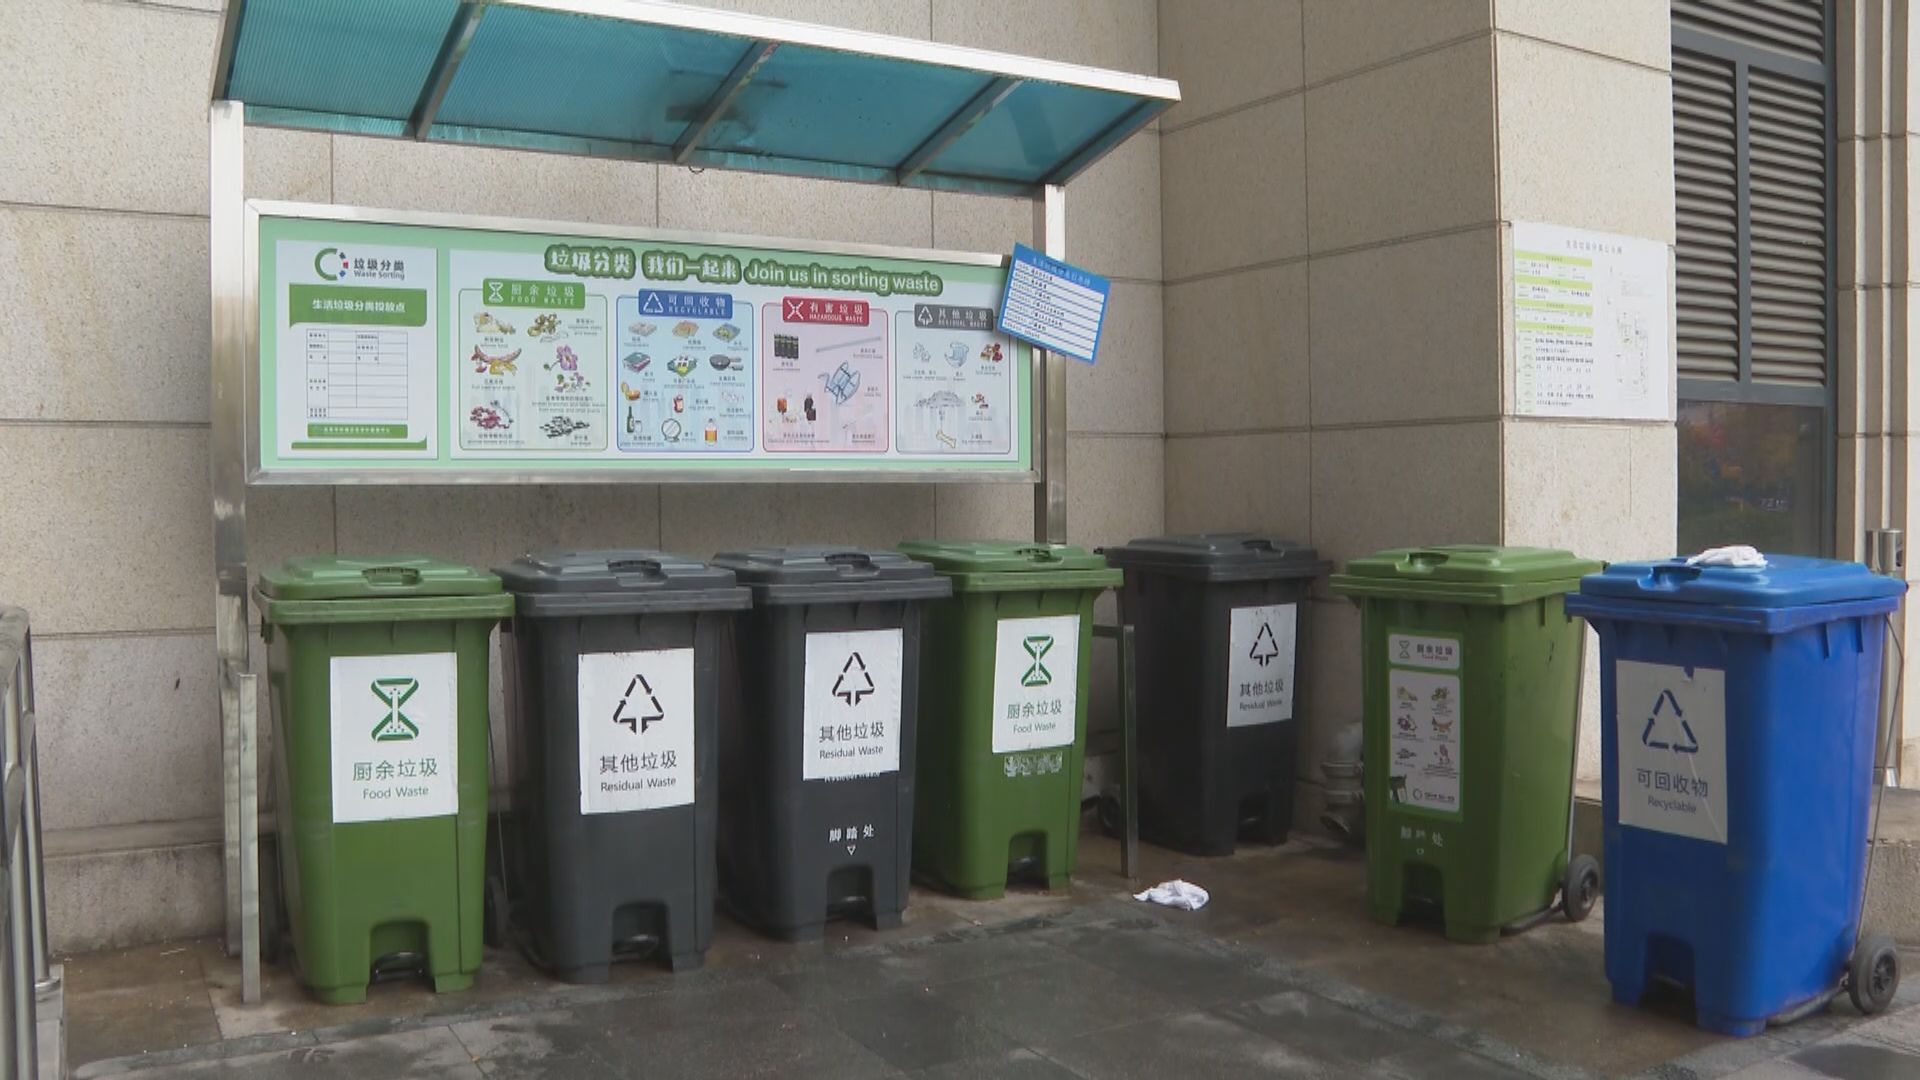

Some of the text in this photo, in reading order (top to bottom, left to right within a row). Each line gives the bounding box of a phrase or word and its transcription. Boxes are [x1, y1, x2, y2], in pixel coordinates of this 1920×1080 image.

[354, 257, 405, 272] 垃圾分类
[550, 250, 939, 292] 垃圾分类 我们一起来 Join us in sorting waste
[354, 270, 405, 280] Waste Sorting
[511, 284, 575, 298] 厨余垃圾
[511, 296, 575, 305] FOOD WASTE
[668, 294, 726, 308] 可回收物
[809, 302, 863, 315] 有害垃圾
[938, 308, 987, 320] 其他垃圾
[809, 314, 863, 323] HAZARDOUS WASTE
[1416, 643, 1453, 656] 厨余垃圾
[1239, 678, 1284, 697] 其他垃圾
[1007, 699, 1062, 719] 厨余垃圾
[1240, 700, 1266, 711] Residual
[819, 721, 885, 743] 其他垃圾
[1013, 722, 1056, 734] Food Waste
[819, 745, 883, 760] Residual Waste
[353, 758, 438, 781] 厨余垃圾
[599, 750, 677, 774] 其他垃圾
[600, 777, 676, 792] Residual Waste
[1636, 767, 1709, 798] 可回收物
[363, 786, 429, 800] Food Waste
[1647, 795, 1697, 814] Recyclable
[829, 824, 874, 843] 脚踏处
